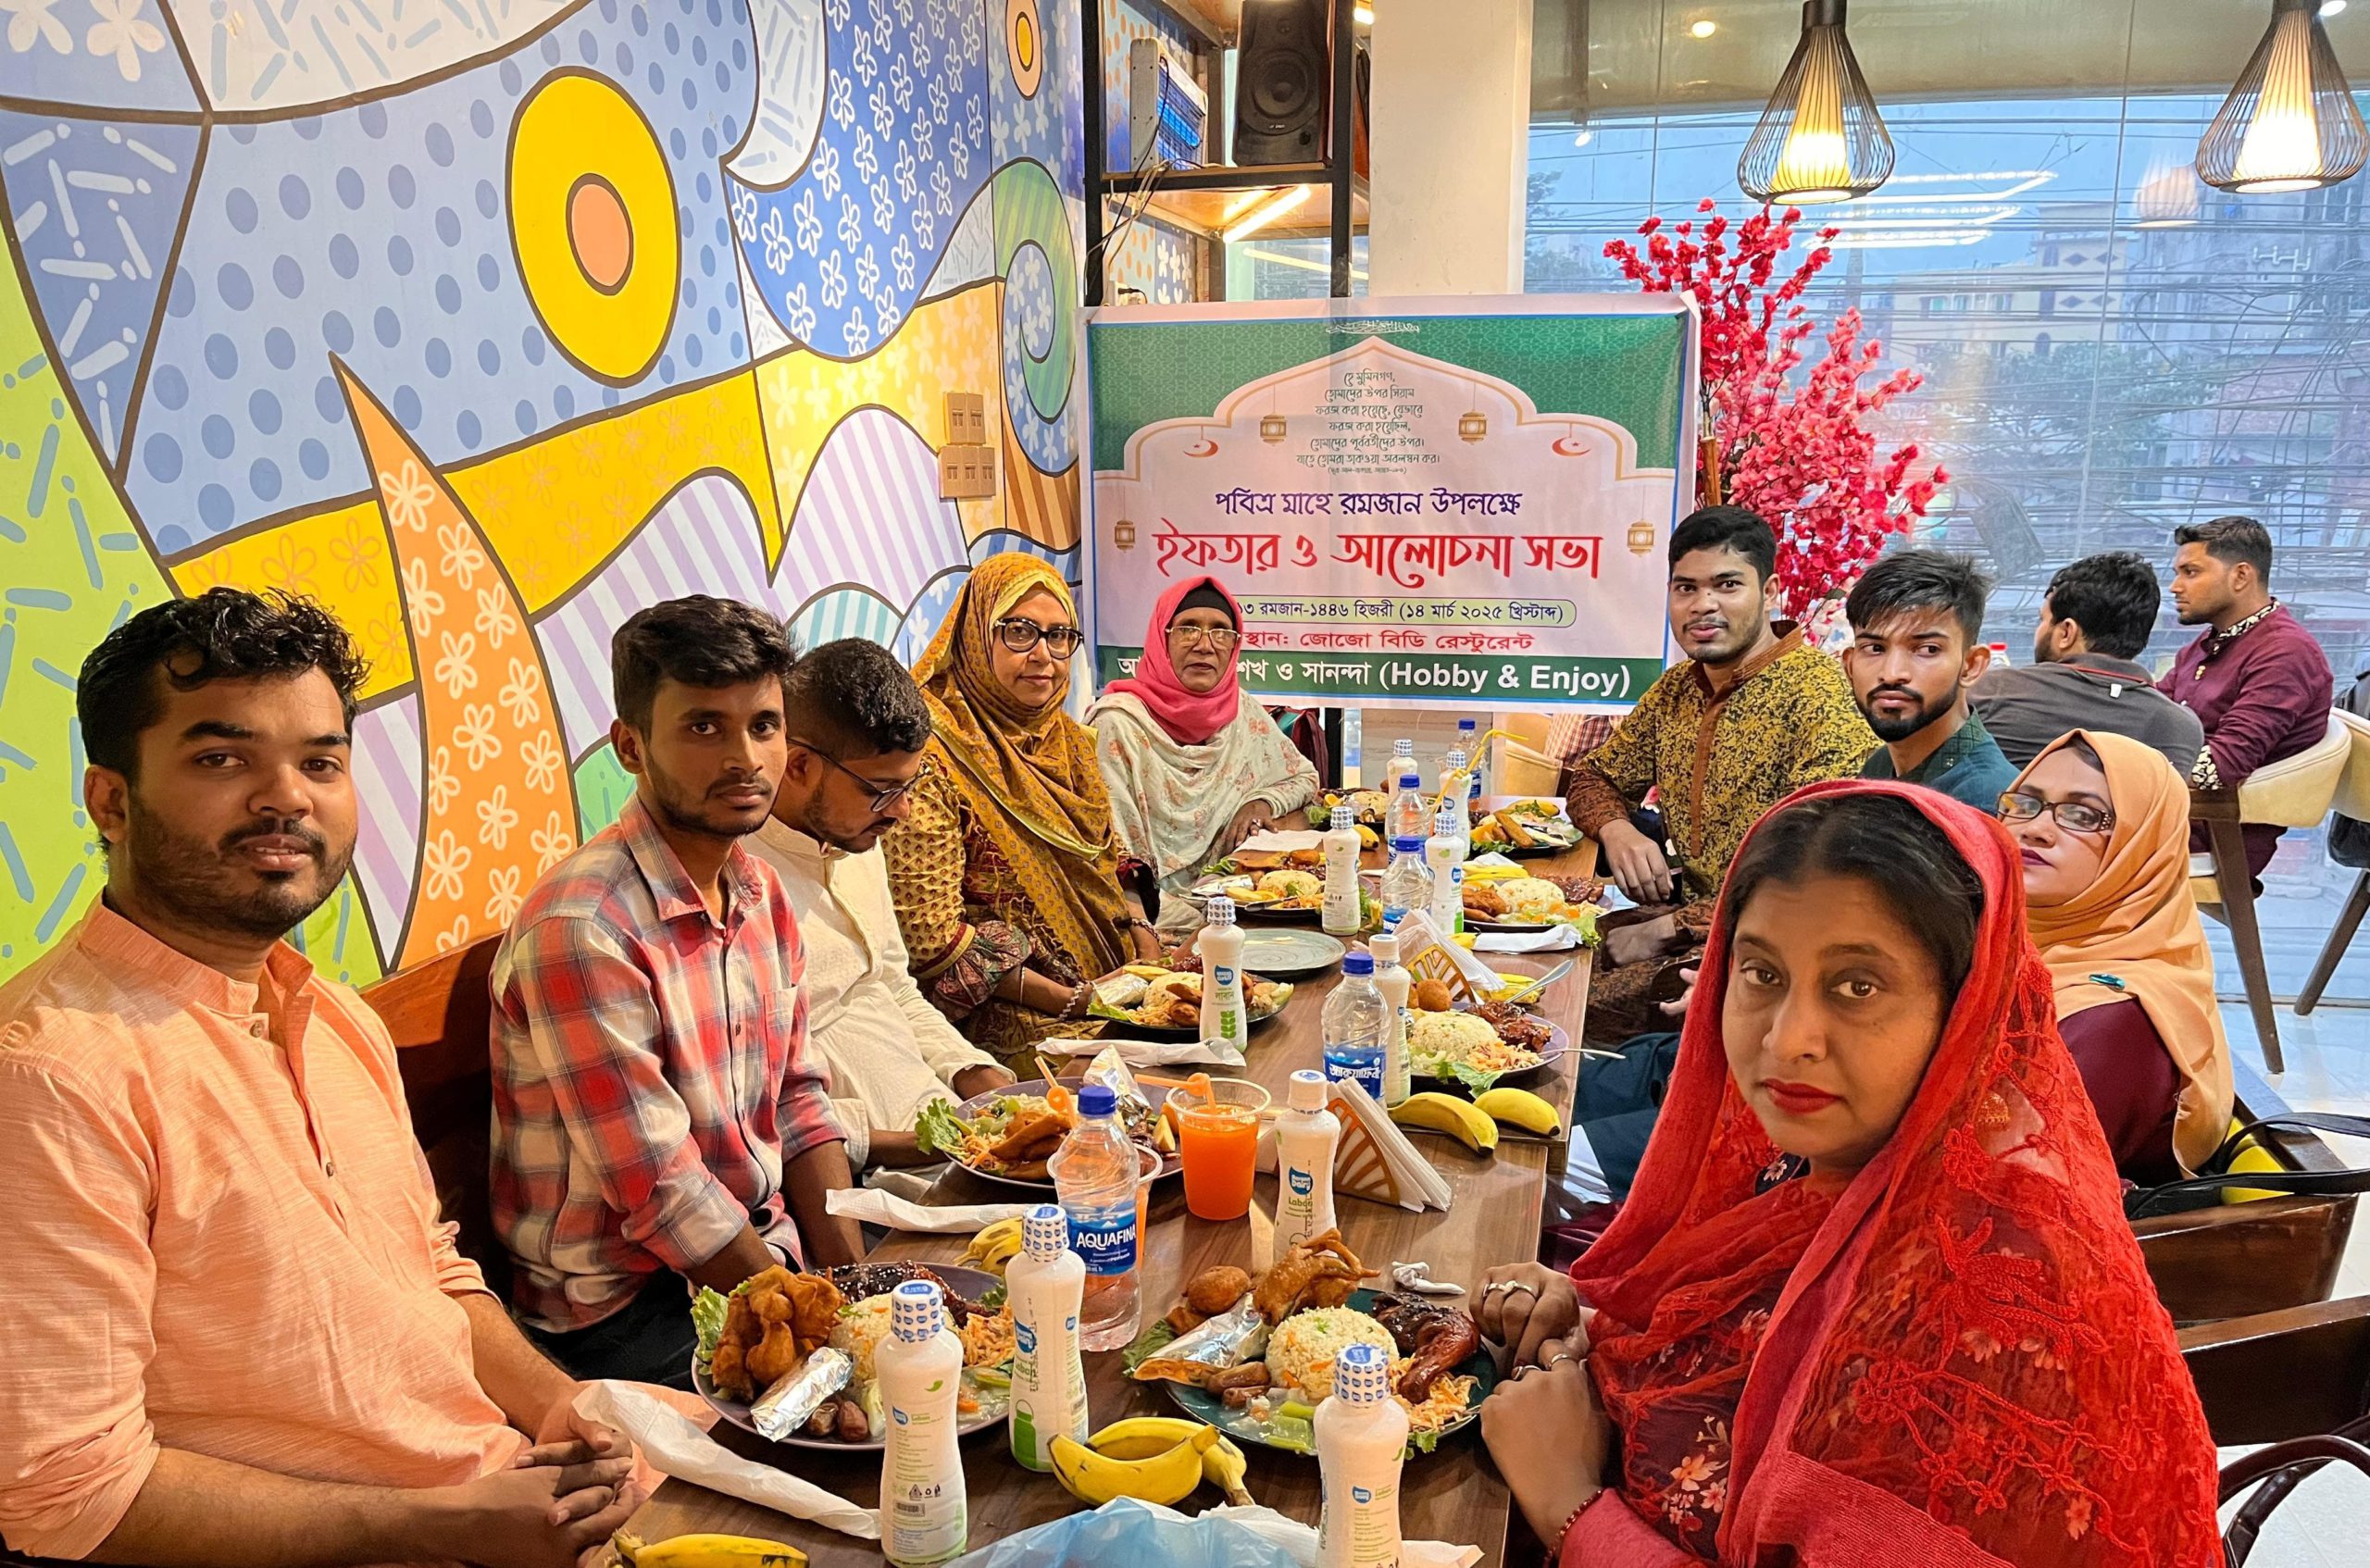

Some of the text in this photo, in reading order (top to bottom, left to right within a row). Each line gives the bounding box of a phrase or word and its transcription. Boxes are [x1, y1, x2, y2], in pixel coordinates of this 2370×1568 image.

[1344, 372, 1353, 386] হে
[1365, 386, 1388, 398] উপর
[1216, 487, 1523, 516] পবিত্র মাহে রমজান উপলক্ষে
[1151, 516, 1604, 590] ইফতার ও আলোচনা সভা
[1353, 599, 1394, 618] হিজরী
[1431, 600, 1456, 619] মার্চ
[1461, 604, 1502, 620] ২০২৫
[1300, 631, 1373, 649] জোজো
[1379, 629, 1428, 649] বিডি
[1435, 631, 1536, 653] রেস্টুরেন্ট
[1276, 661, 1293, 681] ও
[1300, 660, 1373, 686] সানন্দা
[1379, 660, 1490, 694] (Hobby
[1497, 664, 1520, 689] &
[1530, 664, 1631, 699] Enjoy)
